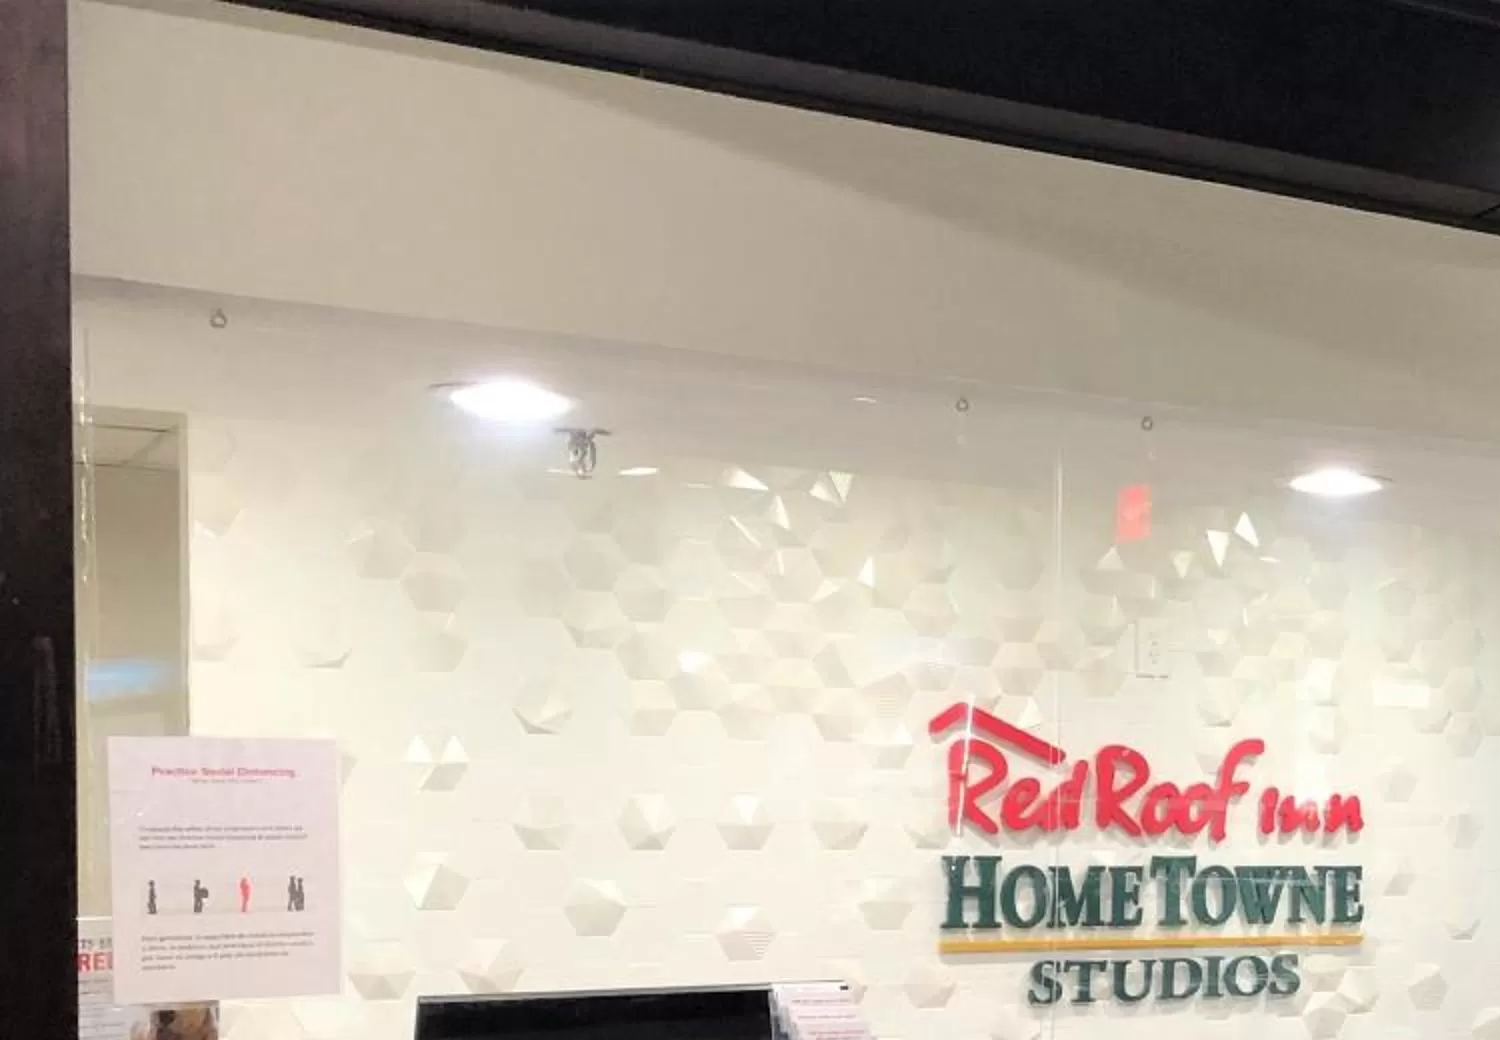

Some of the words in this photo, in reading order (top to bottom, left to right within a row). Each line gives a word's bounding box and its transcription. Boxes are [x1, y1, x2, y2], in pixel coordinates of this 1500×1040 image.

[947, 738, 1089, 835] Red
[1095, 738, 1265, 842] Roof
[1258, 787, 1365, 835] Inn
[1028, 954, 1301, 1006] STUDIOS
